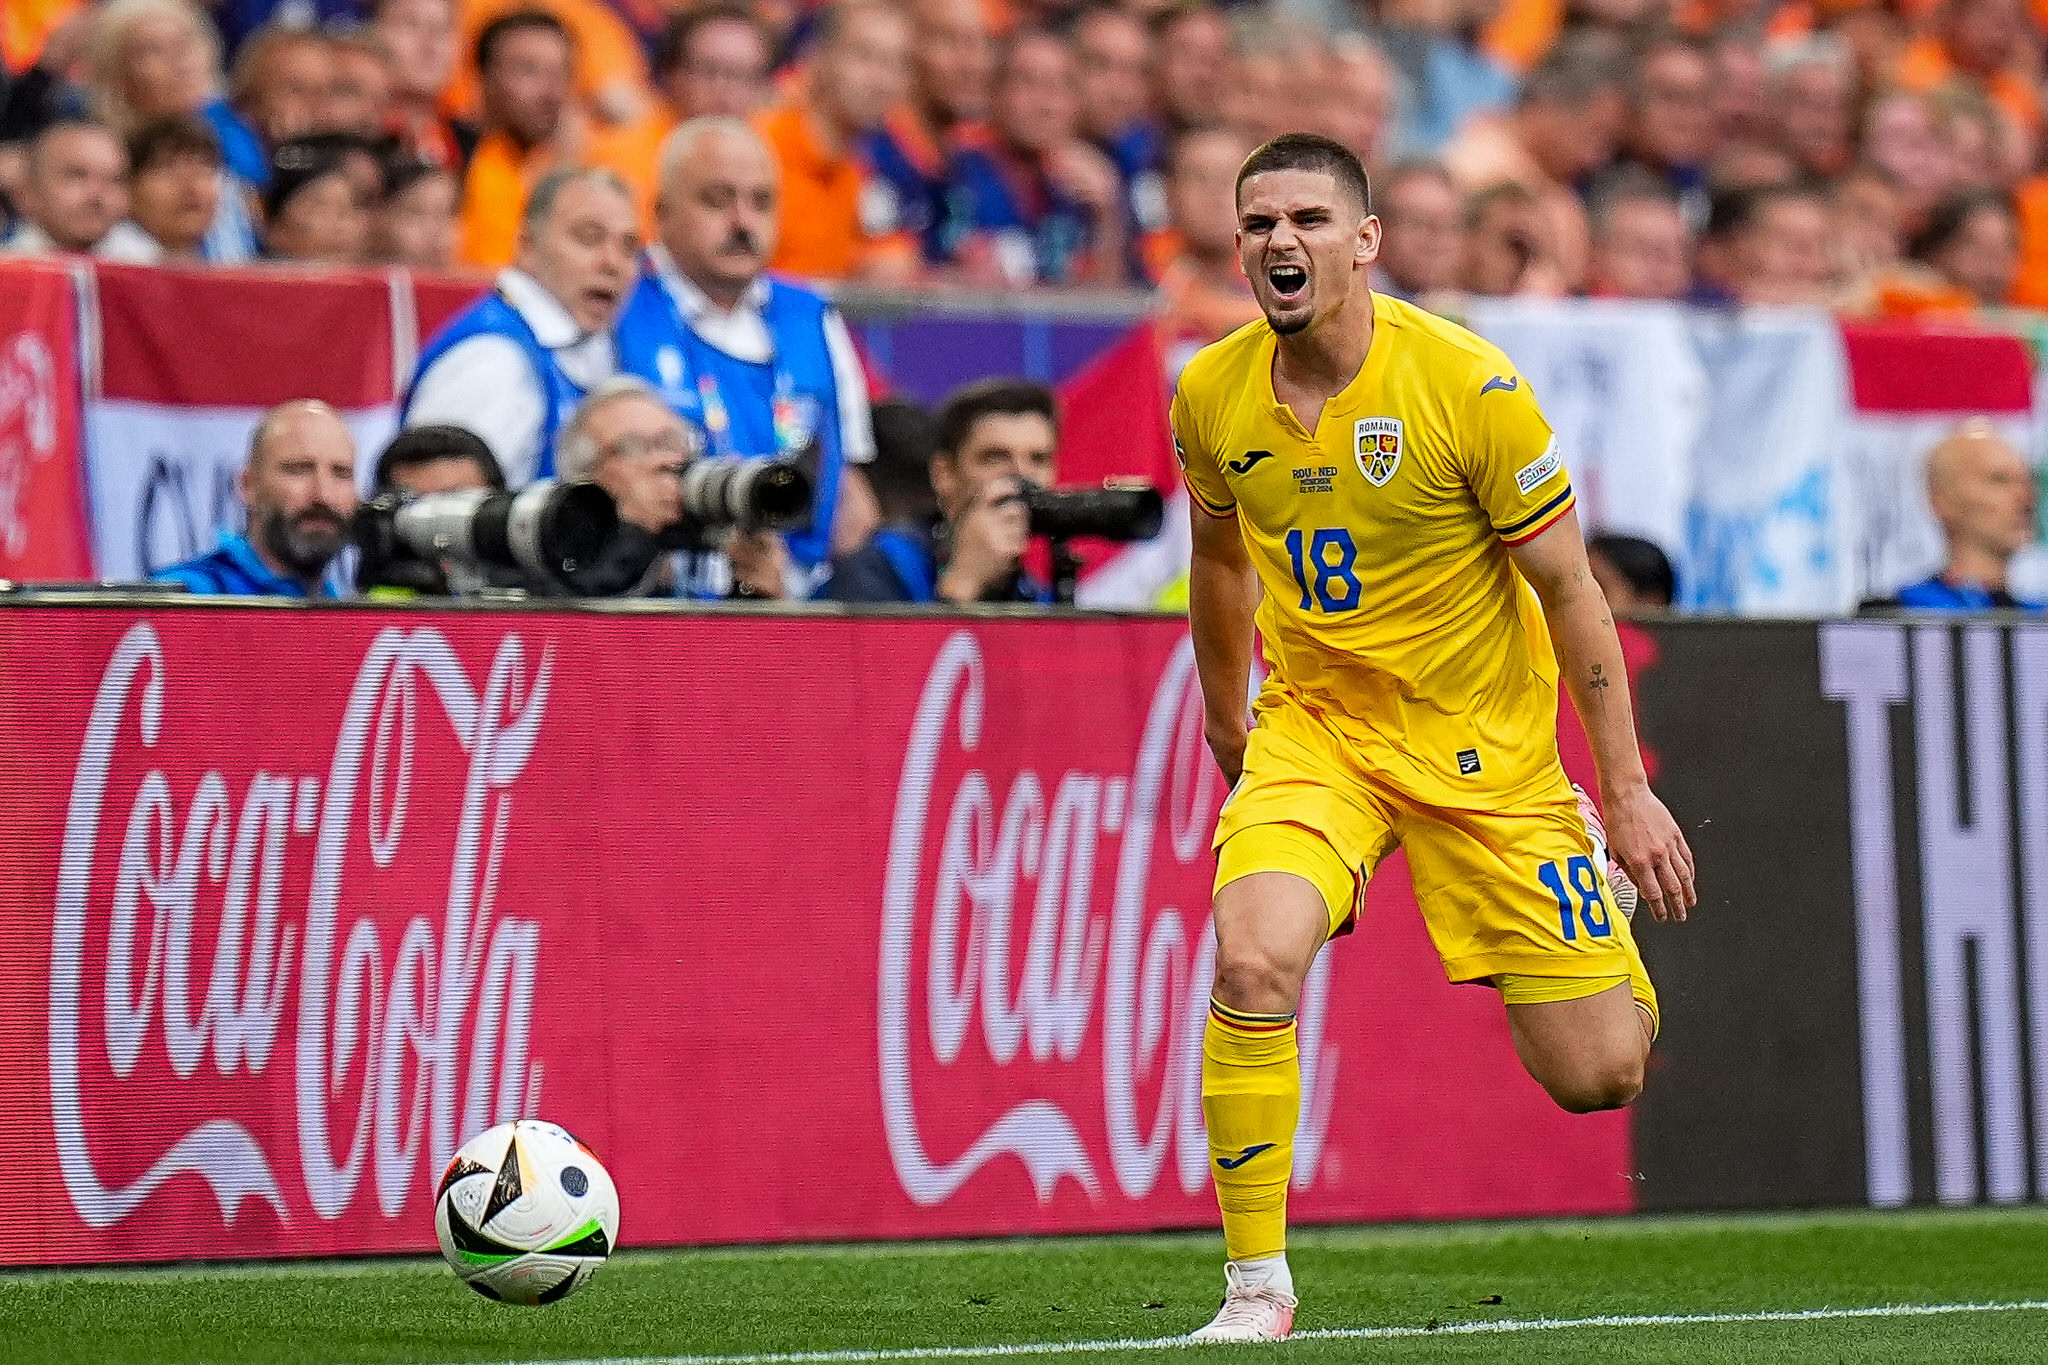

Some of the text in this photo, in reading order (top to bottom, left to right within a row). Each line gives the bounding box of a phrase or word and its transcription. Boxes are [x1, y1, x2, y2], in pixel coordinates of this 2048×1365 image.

[1358, 418, 1398, 434] ROMÂNIA
[1292, 468, 1312, 480] ROU
[1318, 466, 1338, 477] NED
[1284, 528, 1363, 613] 18
[48, 620, 558, 1230] Coca-Cola
[1537, 855, 1612, 941] 18
